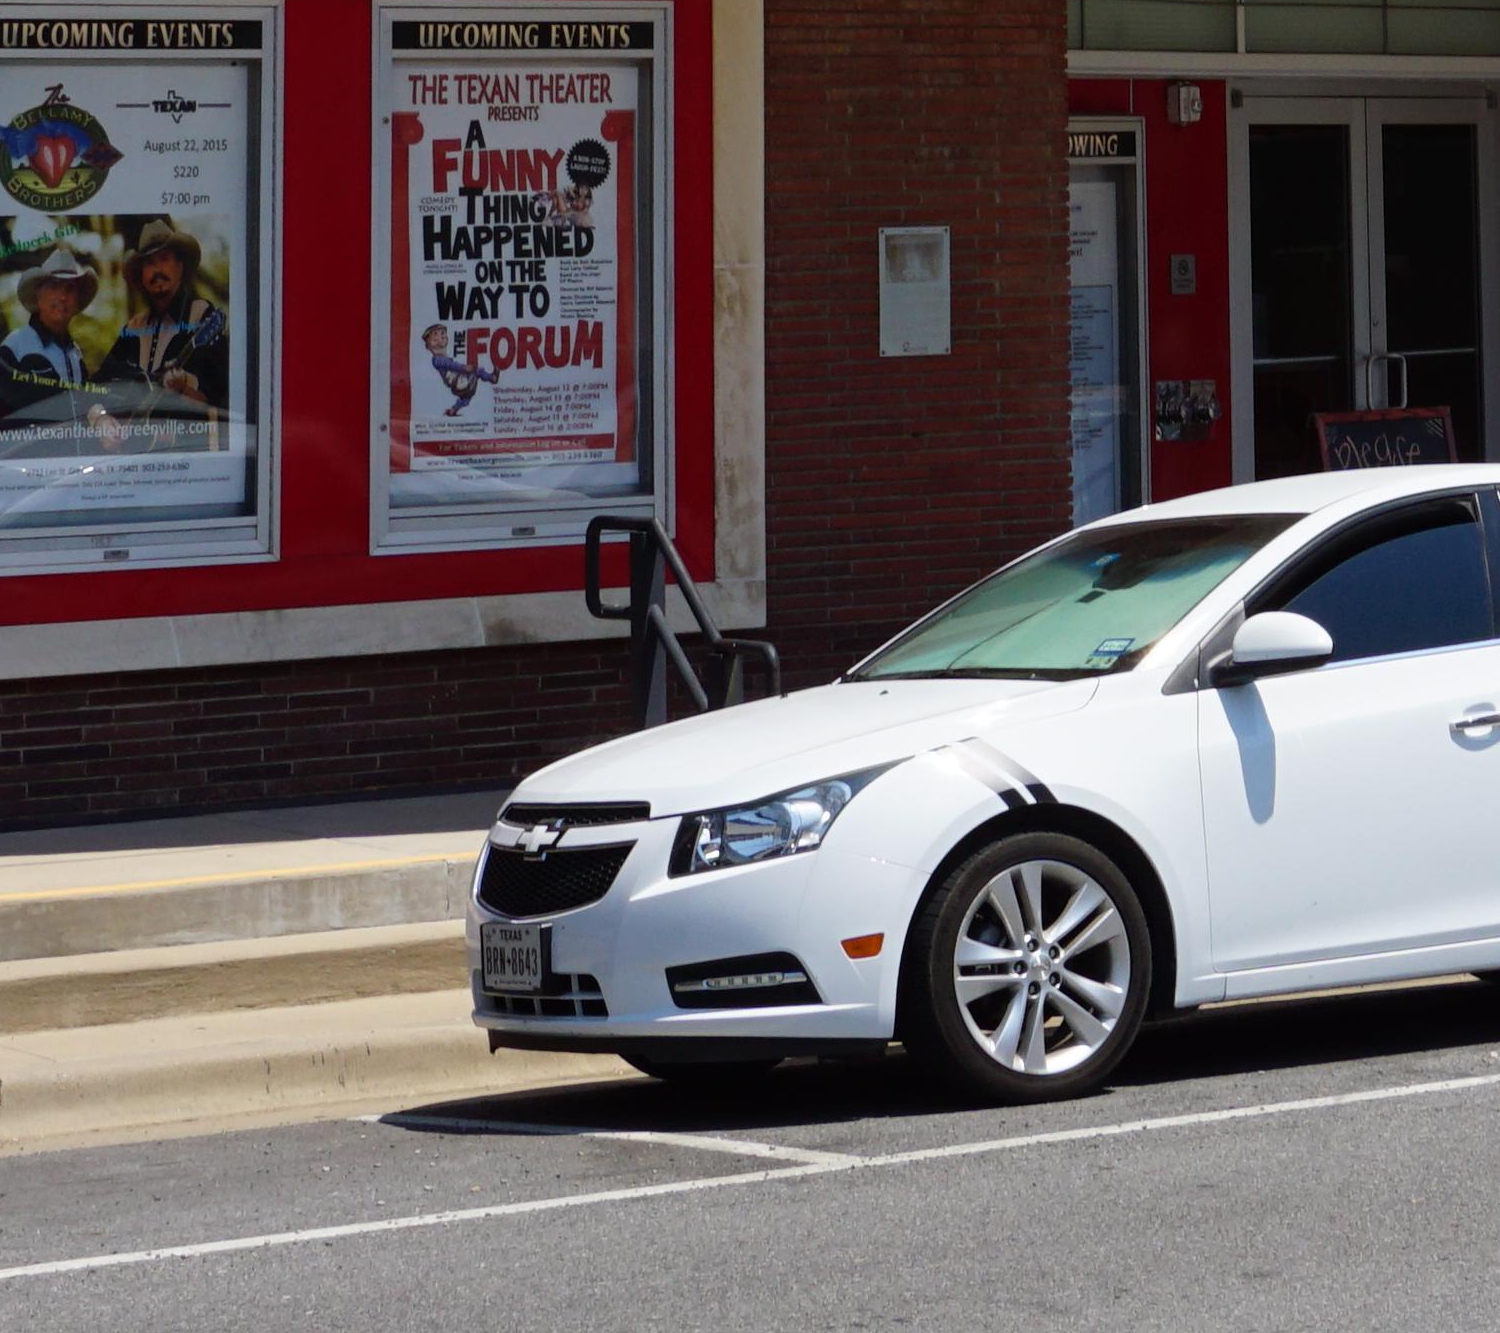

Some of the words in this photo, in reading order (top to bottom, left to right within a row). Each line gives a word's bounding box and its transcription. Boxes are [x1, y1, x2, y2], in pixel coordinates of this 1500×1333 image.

[2, 22, 134, 47] UPCOMING
[147, 22, 234, 47] EVENTS
[419, 23, 539, 48] UPCOMING
[550, 24, 631, 48] EVENTS
[44, 84, 71, 106] The
[408, 74, 448, 105] THE
[454, 73, 520, 105] TEXAN
[525, 73, 613, 104] THEATER
[152, 100, 197, 113] TEXAN
[488, 106, 539, 122] PRESENTS
[13, 108, 95, 131] BELLAMY
[465, 120, 486, 149] A
[144, 140, 180, 154] August
[183, 140, 200, 153] 22,
[202, 139, 228, 152] 2015
[173, 165, 199, 178] $220
[432, 138, 566, 193] FUNNY
[7, 179, 98, 207] BROTHERS
[161, 192, 191, 205] $7:00
[192, 194, 211, 206] pm
[420, 196, 455, 205] COMEDY
[418, 204, 459, 214] TONIGHT!
[459, 187, 547, 225] THING
[422, 215, 596, 262] HAPPENED
[475, 261, 503, 283] ON
[506, 260, 547, 283] THE
[435, 281, 504, 321] WAY
[508, 284, 550, 319] TO
[453, 330, 466, 358] THE
[466, 320, 604, 371] FORUM
[0, 418, 218, 442] www.texantheatergreenville.com
[499, 928, 523, 942] TEXAS
